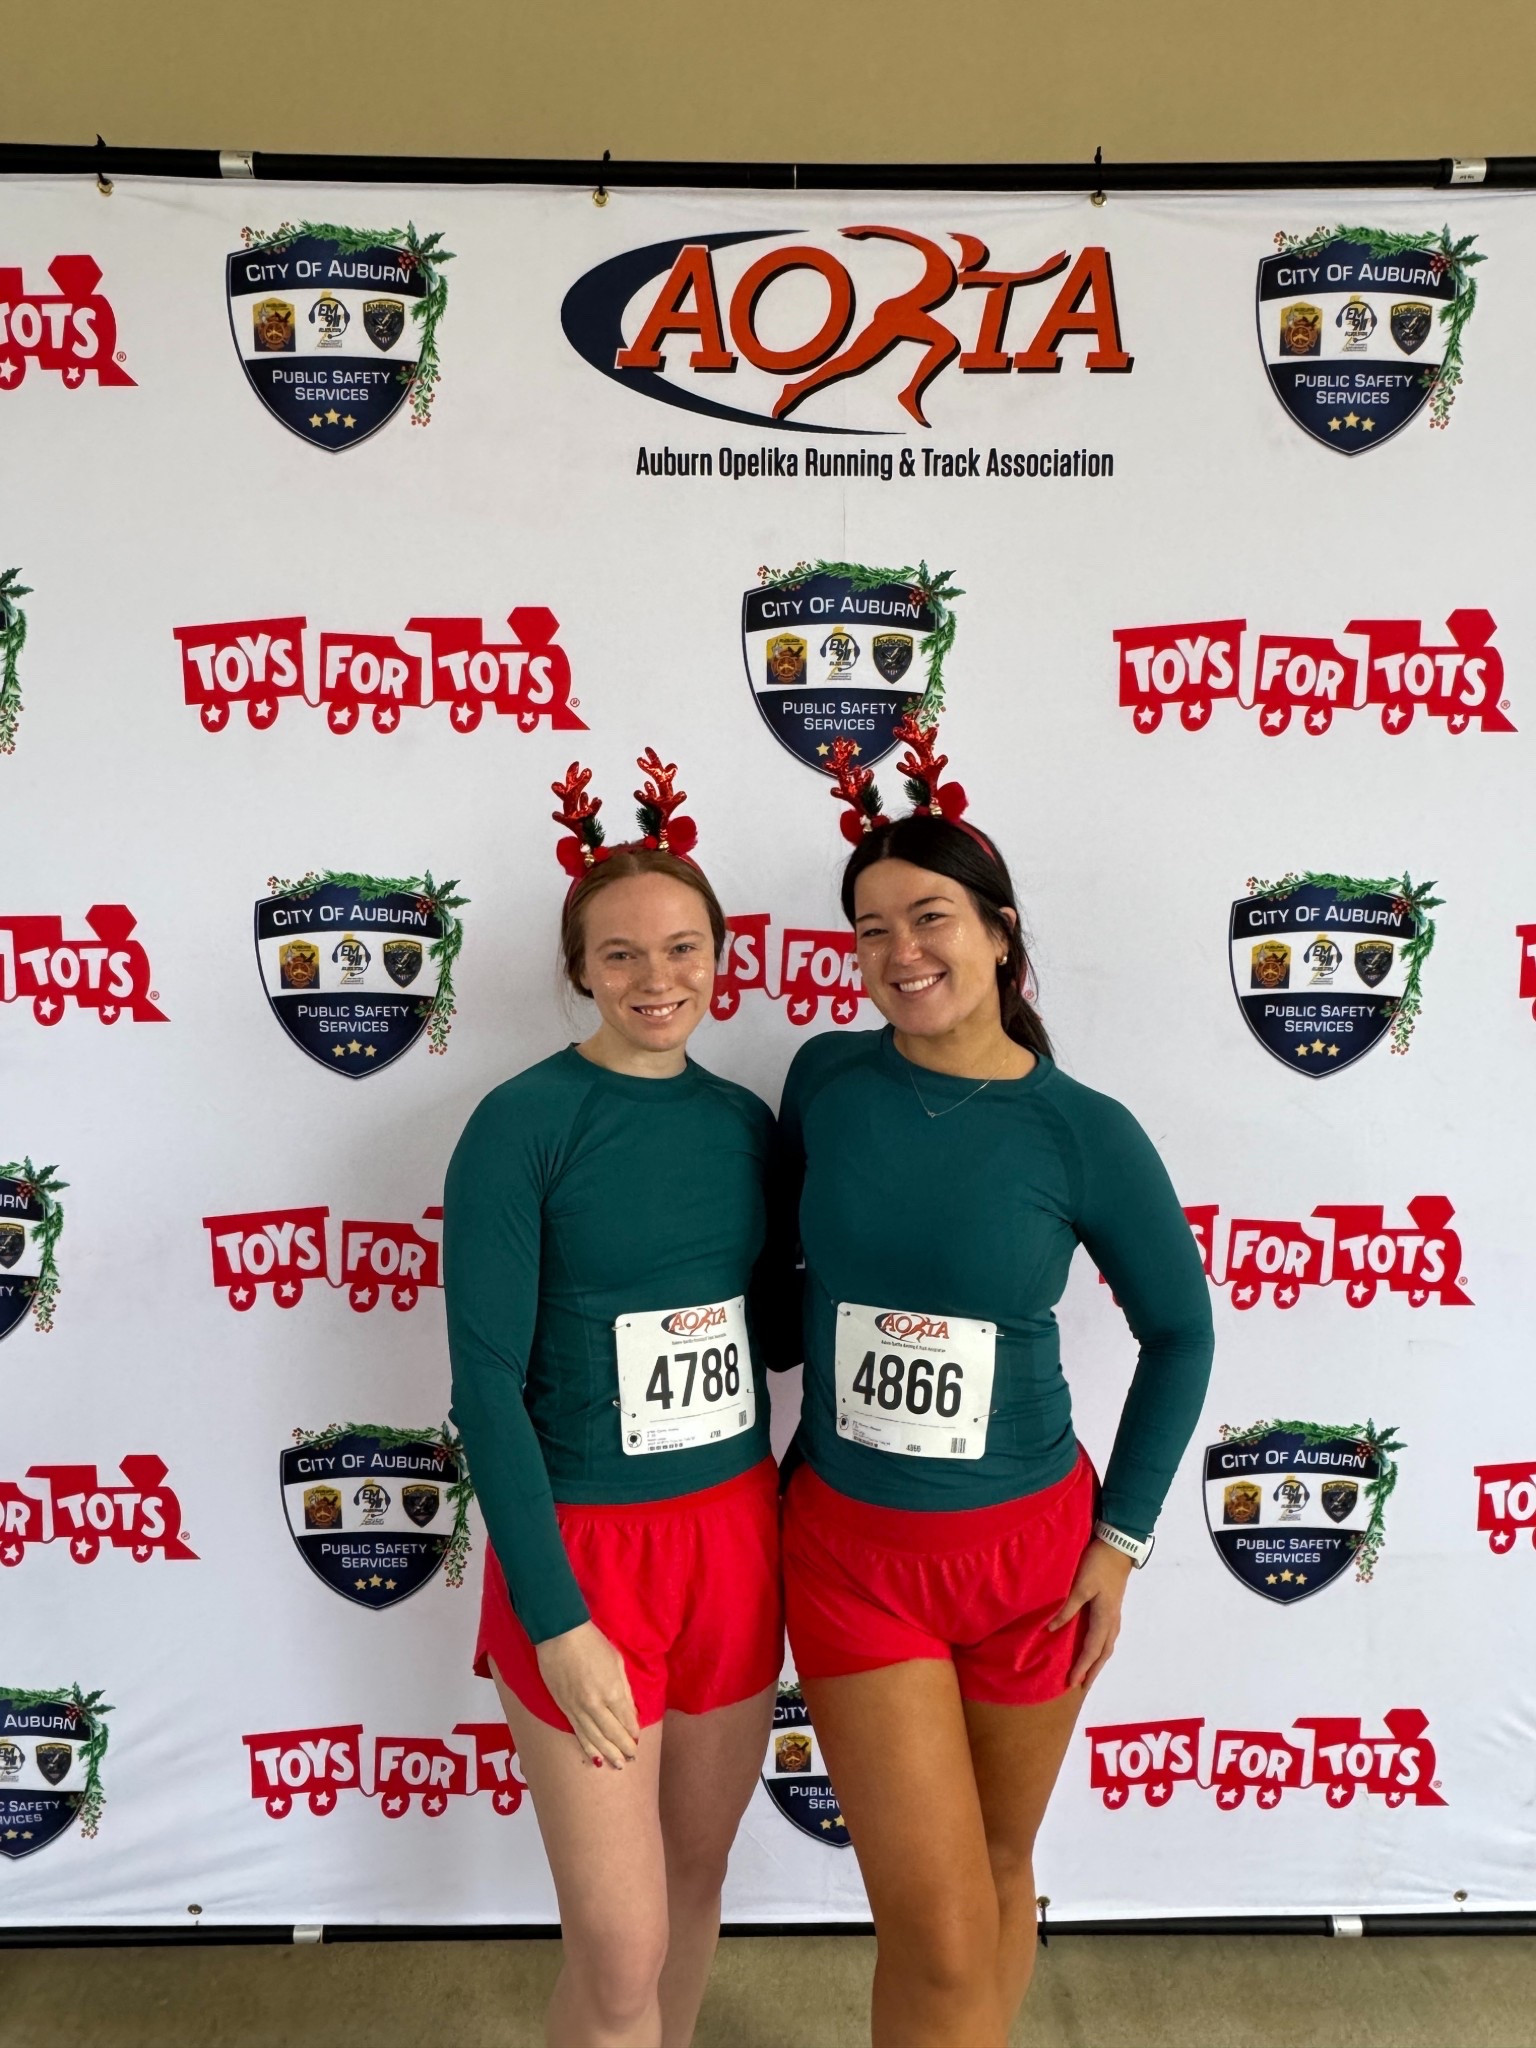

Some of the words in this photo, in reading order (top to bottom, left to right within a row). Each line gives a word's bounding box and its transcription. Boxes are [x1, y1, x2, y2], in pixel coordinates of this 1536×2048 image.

[246, 263, 289, 283] CITY
[296, 260, 322, 277] OF
[328, 260, 411, 284] AUBURN
[1277, 267, 1320, 287] CITY
[1327, 264, 1353, 281] OF
[1358, 263, 1442, 287] AUBURN
[615, 225, 1135, 428] AORTA
[272, 371, 327, 384] PUBLIC
[333, 370, 391, 384] SAFETY
[1295, 374, 1350, 387] PUBLIC
[1354, 374, 1413, 388] SAFETY
[295, 387, 369, 401] SERVICES
[1316, 391, 1390, 404] SERVICES
[636, 448, 713, 477] Auburn
[718, 447, 798, 481] Opelika
[805, 448, 893, 480] Running
[899, 449, 917, 477] &
[921, 449, 980, 477] Track
[986, 449, 1114, 478] Association
[761, 600, 804, 619] CITY
[809, 596, 835, 614] OF
[840, 596, 922, 619] AUBURN
[187, 633, 299, 692] TOYS
[325, 647, 410, 700] FOR
[439, 649, 554, 704] TOTS
[1124, 635, 1232, 695] TOYS
[1259, 648, 1346, 701] FOR
[1373, 651, 1488, 705] TOTS
[783, 701, 836, 715] PUBLIC
[840, 701, 897, 715] SAFETY
[804, 718, 876, 731] SERVICES
[272, 908, 313, 927] CITY
[319, 905, 345, 922] OF
[350, 905, 428, 927] AUBURN
[1249, 909, 1289, 927] CITY
[1295, 906, 1321, 923] OF
[1326, 905, 1402, 927] AUBURN
[19, 946, 133, 998] TOTS
[298, 1005, 350, 1018] PUBLIC
[354, 1004, 410, 1018] SAFETY
[1264, 1004, 1317, 1018] PUBLIC
[1321, 1004, 1376, 1018] SAFETY
[319, 1020, 389, 1033] SERVICES
[1284, 1020, 1354, 1033] SERVICES
[216, 1222, 321, 1275] TOYS
[346, 1232, 428, 1280] FOR
[1231, 1230, 1313, 1278] FOR
[1338, 1235, 1446, 1283] TOTS
[645, 1342, 740, 1410] 4788
[852, 1350, 964, 1418] 4866
[297, 1457, 336, 1473] CITY
[341, 1453, 365, 1469] OF
[370, 1453, 444, 1472] AUBURN
[1221, 1453, 1259, 1469] CITY
[1265, 1450, 1289, 1465] OF
[1293, 1450, 1367, 1469] AUBURN
[1484, 1474, 1536, 1521] TO
[56, 1492, 166, 1539] TOTS
[321, 1543, 371, 1555] PUBLIC
[375, 1542, 427, 1554] SAFETY
[1236, 1538, 1286, 1550] PUBLIC
[1289, 1538, 1341, 1550] SAFETY
[341, 1557, 408, 1568] SERVICES
[1255, 1552, 1321, 1564] SERVICES
[4, 1714, 77, 1731] AUBURN
[773, 1706, 808, 1721] CITY
[254, 1738, 355, 1788] TOYS
[379, 1746, 456, 1789] FOR
[1095, 1729, 1194, 1779] TOYS
[1216, 1739, 1293, 1782] FOR
[1318, 1742, 1421, 1786] TOTS
[9, 1800, 60, 1812] SAFETY
